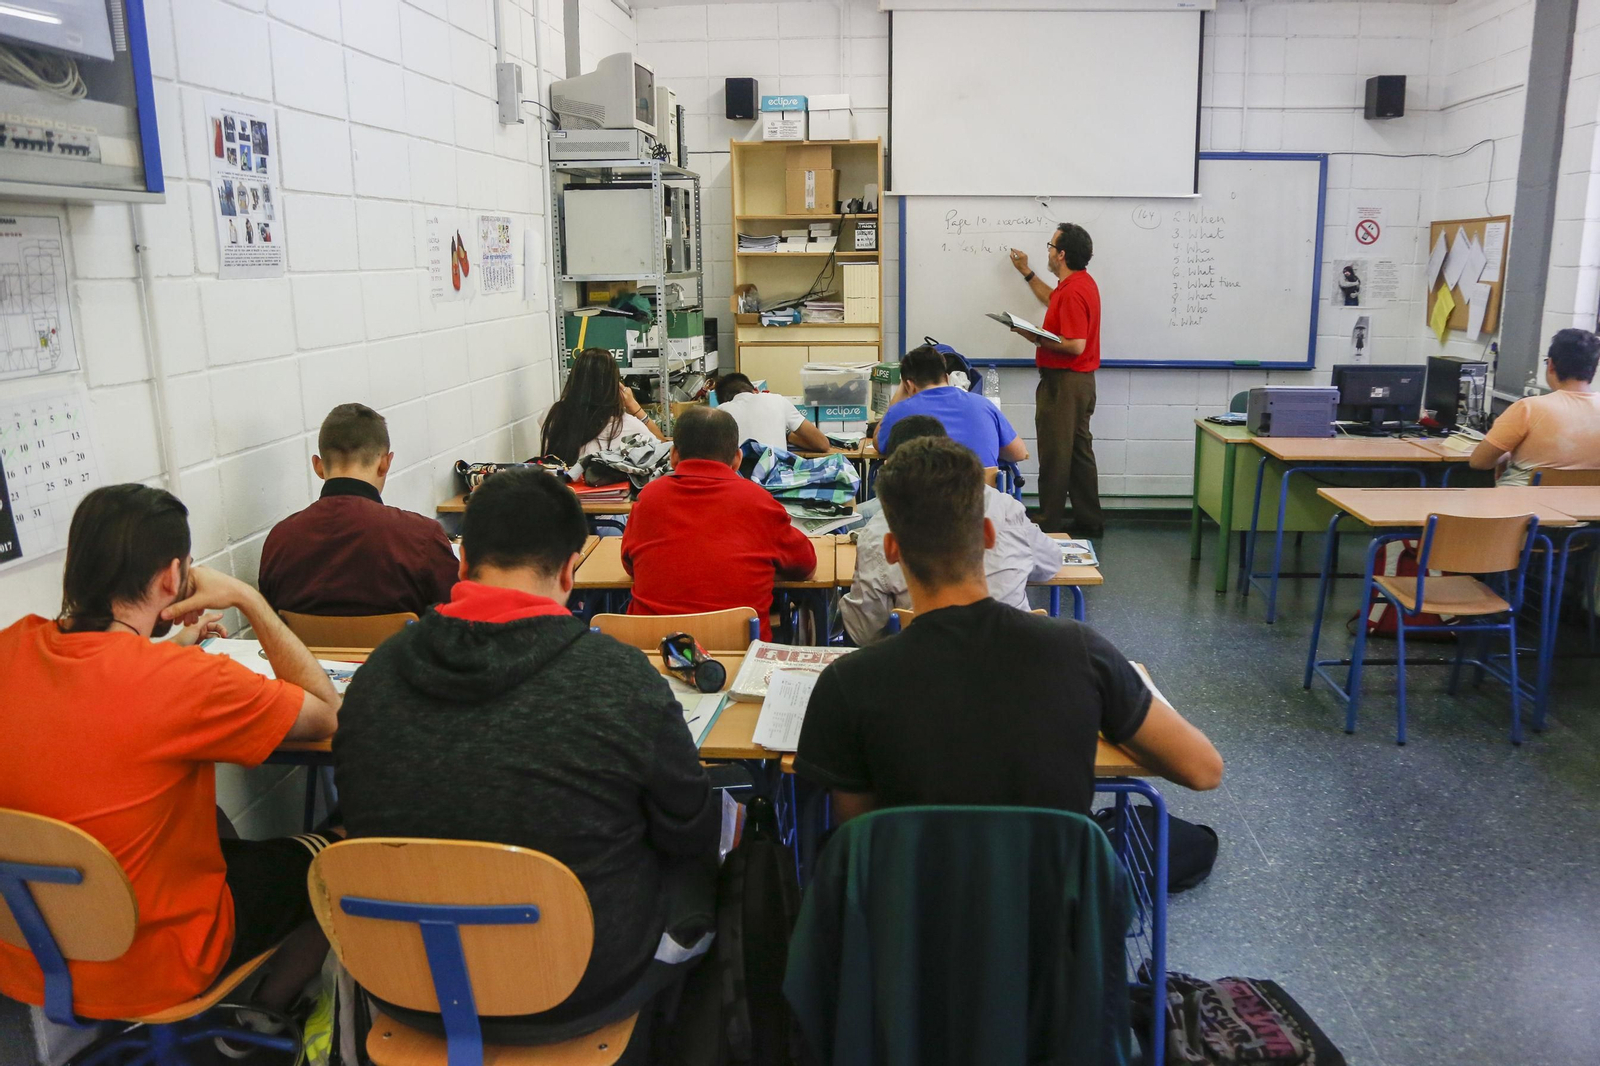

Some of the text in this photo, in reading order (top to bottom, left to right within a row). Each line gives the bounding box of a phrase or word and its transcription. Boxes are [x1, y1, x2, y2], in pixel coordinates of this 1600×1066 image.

[767, 97, 798, 107] eclipse
[945, 209, 970, 235] Page
[996, 216, 1035, 226] exercise
[1188, 205, 1226, 225] When
[1188, 226, 1225, 240] What
[979, 240, 992, 254] he
[999, 243, 1008, 252] is
[1218, 276, 1242, 288] time
[826, 405, 861, 418] eclipse
[16, 412, 72, 431] 3 4 5 6
[20, 443, 29, 453] 10
[37, 439, 45, 449] 11
[71, 431, 81, 441] 13
[6, 452, 86, 480] 16 17 18 19 20
[11, 472, 90, 502] 23 25 26 27
[15, 508, 42, 524] 30 31
